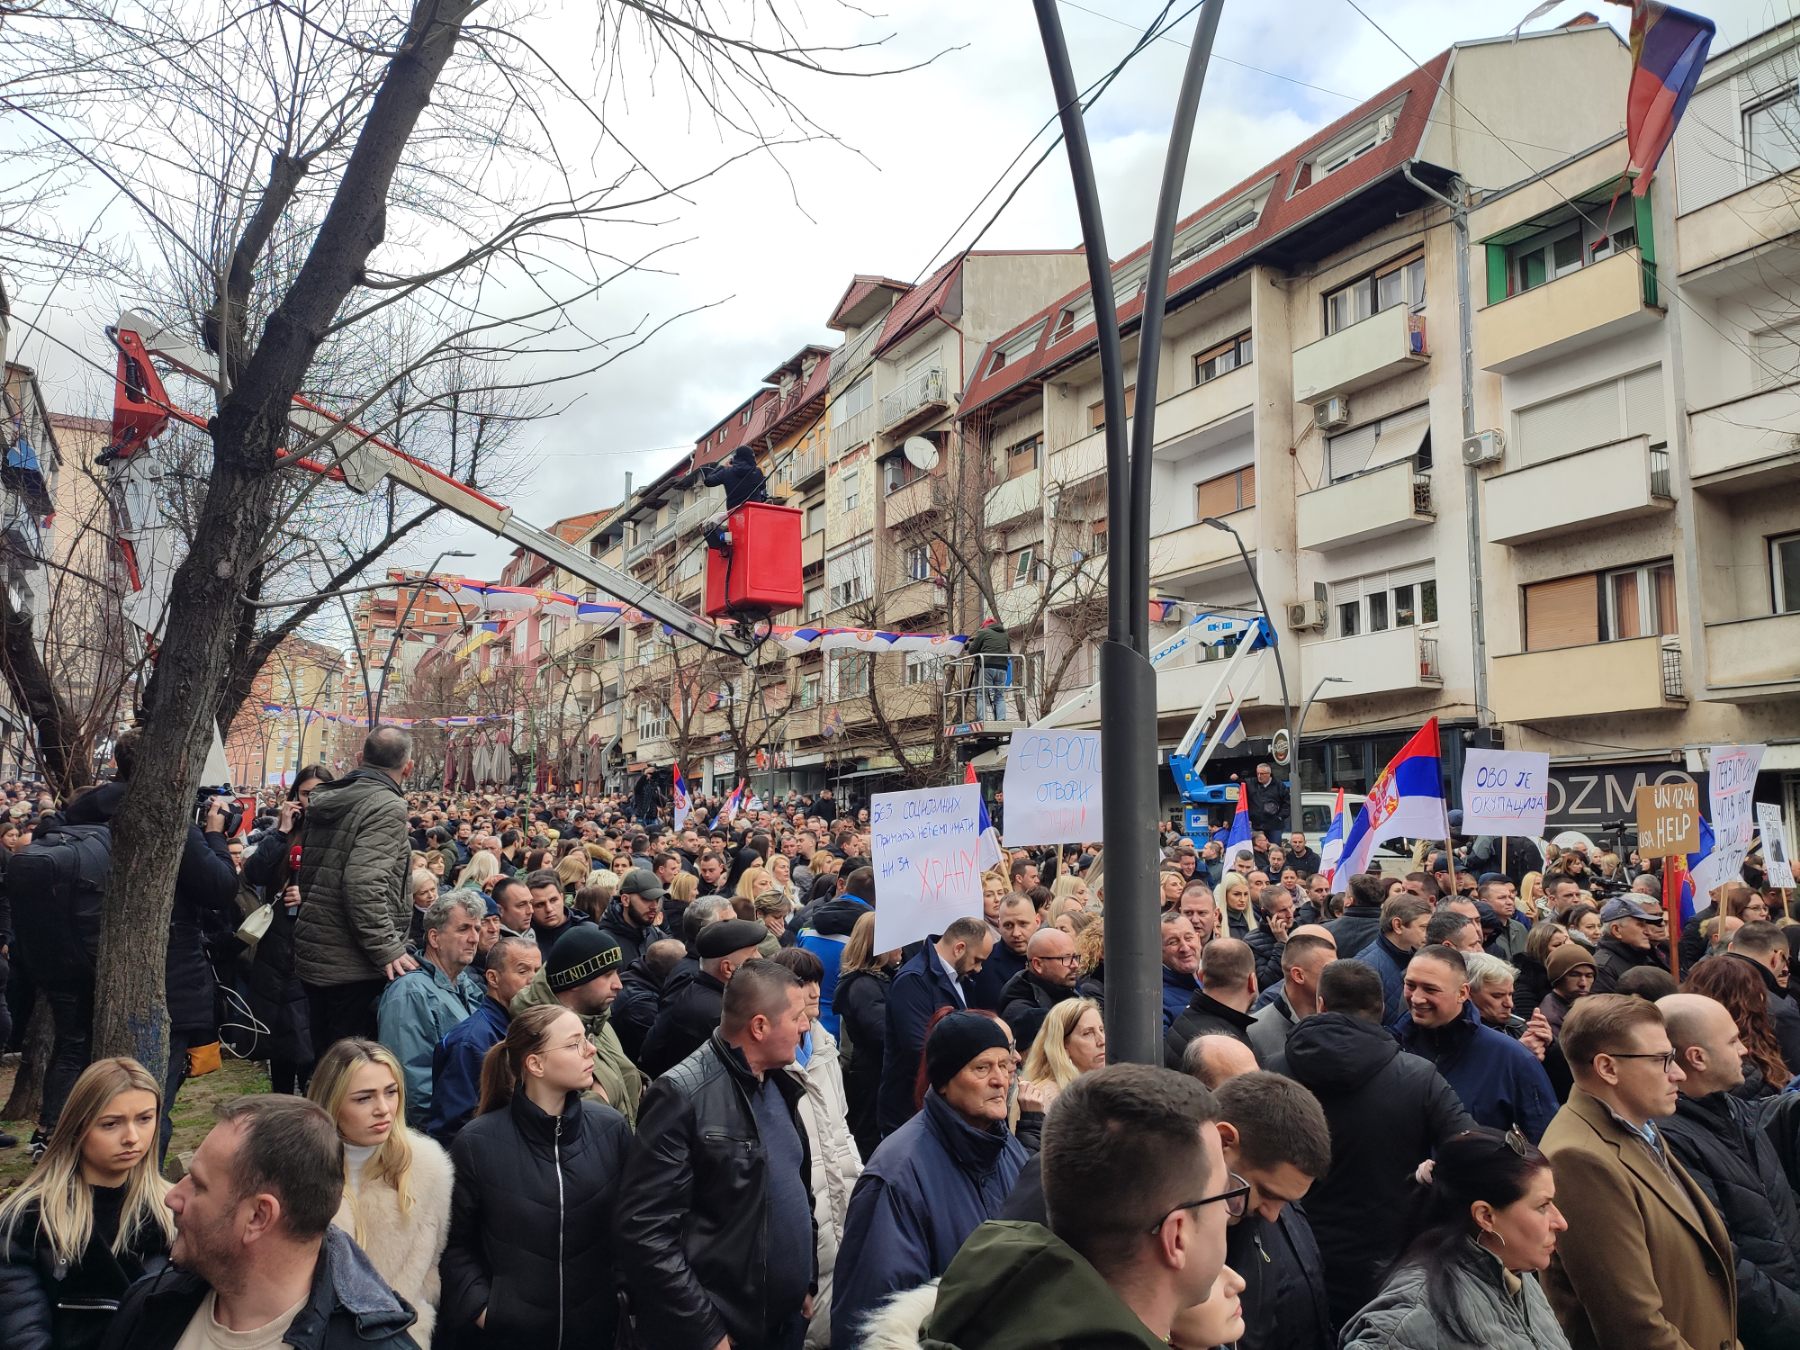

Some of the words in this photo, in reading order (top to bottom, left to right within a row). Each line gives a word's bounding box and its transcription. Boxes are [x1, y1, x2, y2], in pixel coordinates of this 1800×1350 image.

[1476, 766, 1508, 788] ОВО
[1037, 780, 1094, 803] ОТВОРИ
[1654, 788, 1670, 809] UN
[1672, 785, 1695, 809] 1244
[1640, 831, 1655, 849] USA
[1656, 813, 1691, 849] HELP
[898, 856, 909, 872] ЗА
